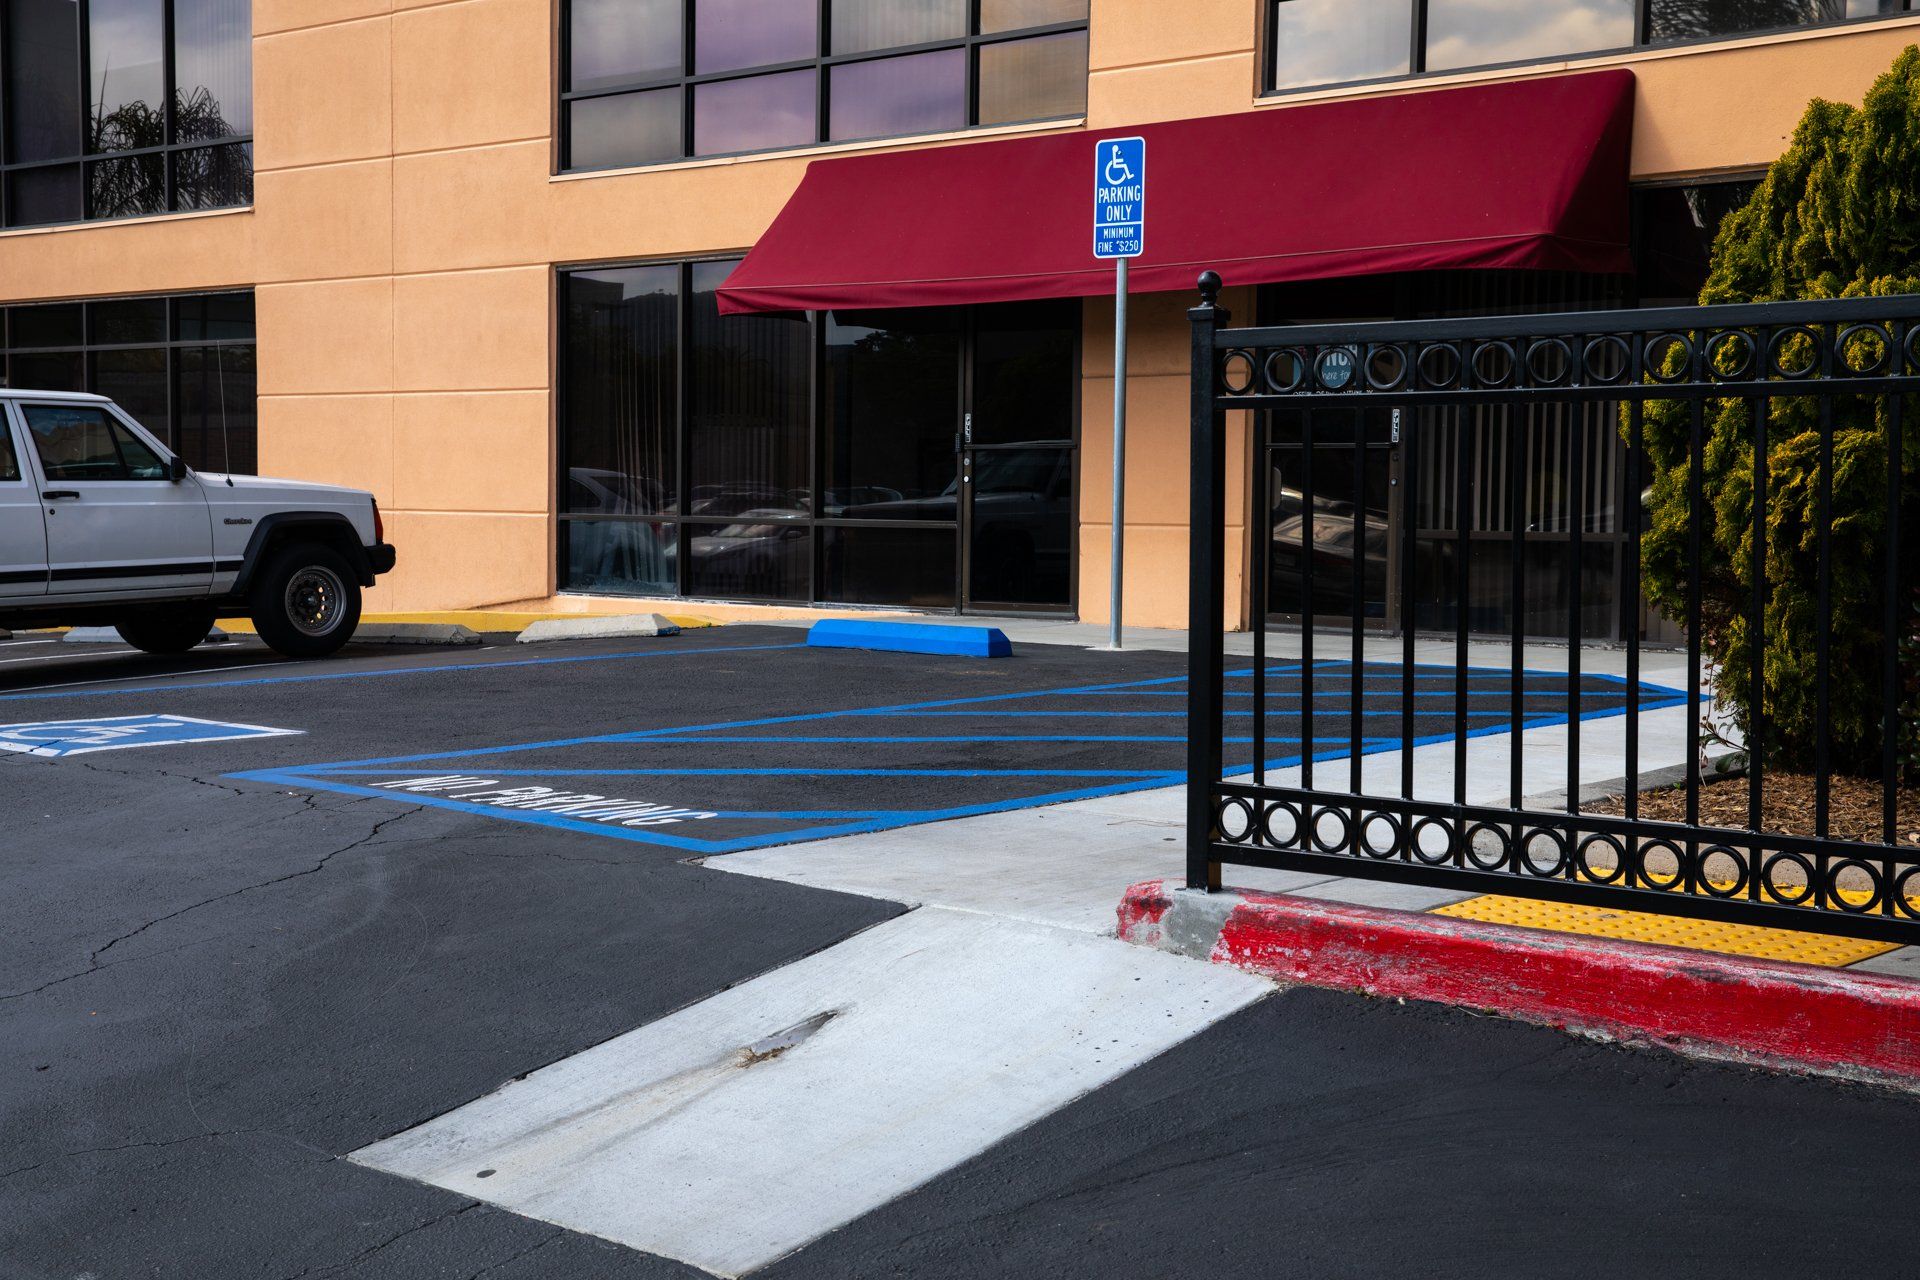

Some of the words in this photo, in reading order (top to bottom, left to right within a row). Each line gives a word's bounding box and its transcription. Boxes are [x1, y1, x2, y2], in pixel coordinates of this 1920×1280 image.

[1098, 185, 1141, 203] PARKING
[1106, 205, 1132, 221] ONLY
[1103, 226, 1134, 239] MINIMUM
[1097, 241, 1113, 253] FINE
[368, 775, 500, 792] NO
[448, 786, 719, 826] PARKING
